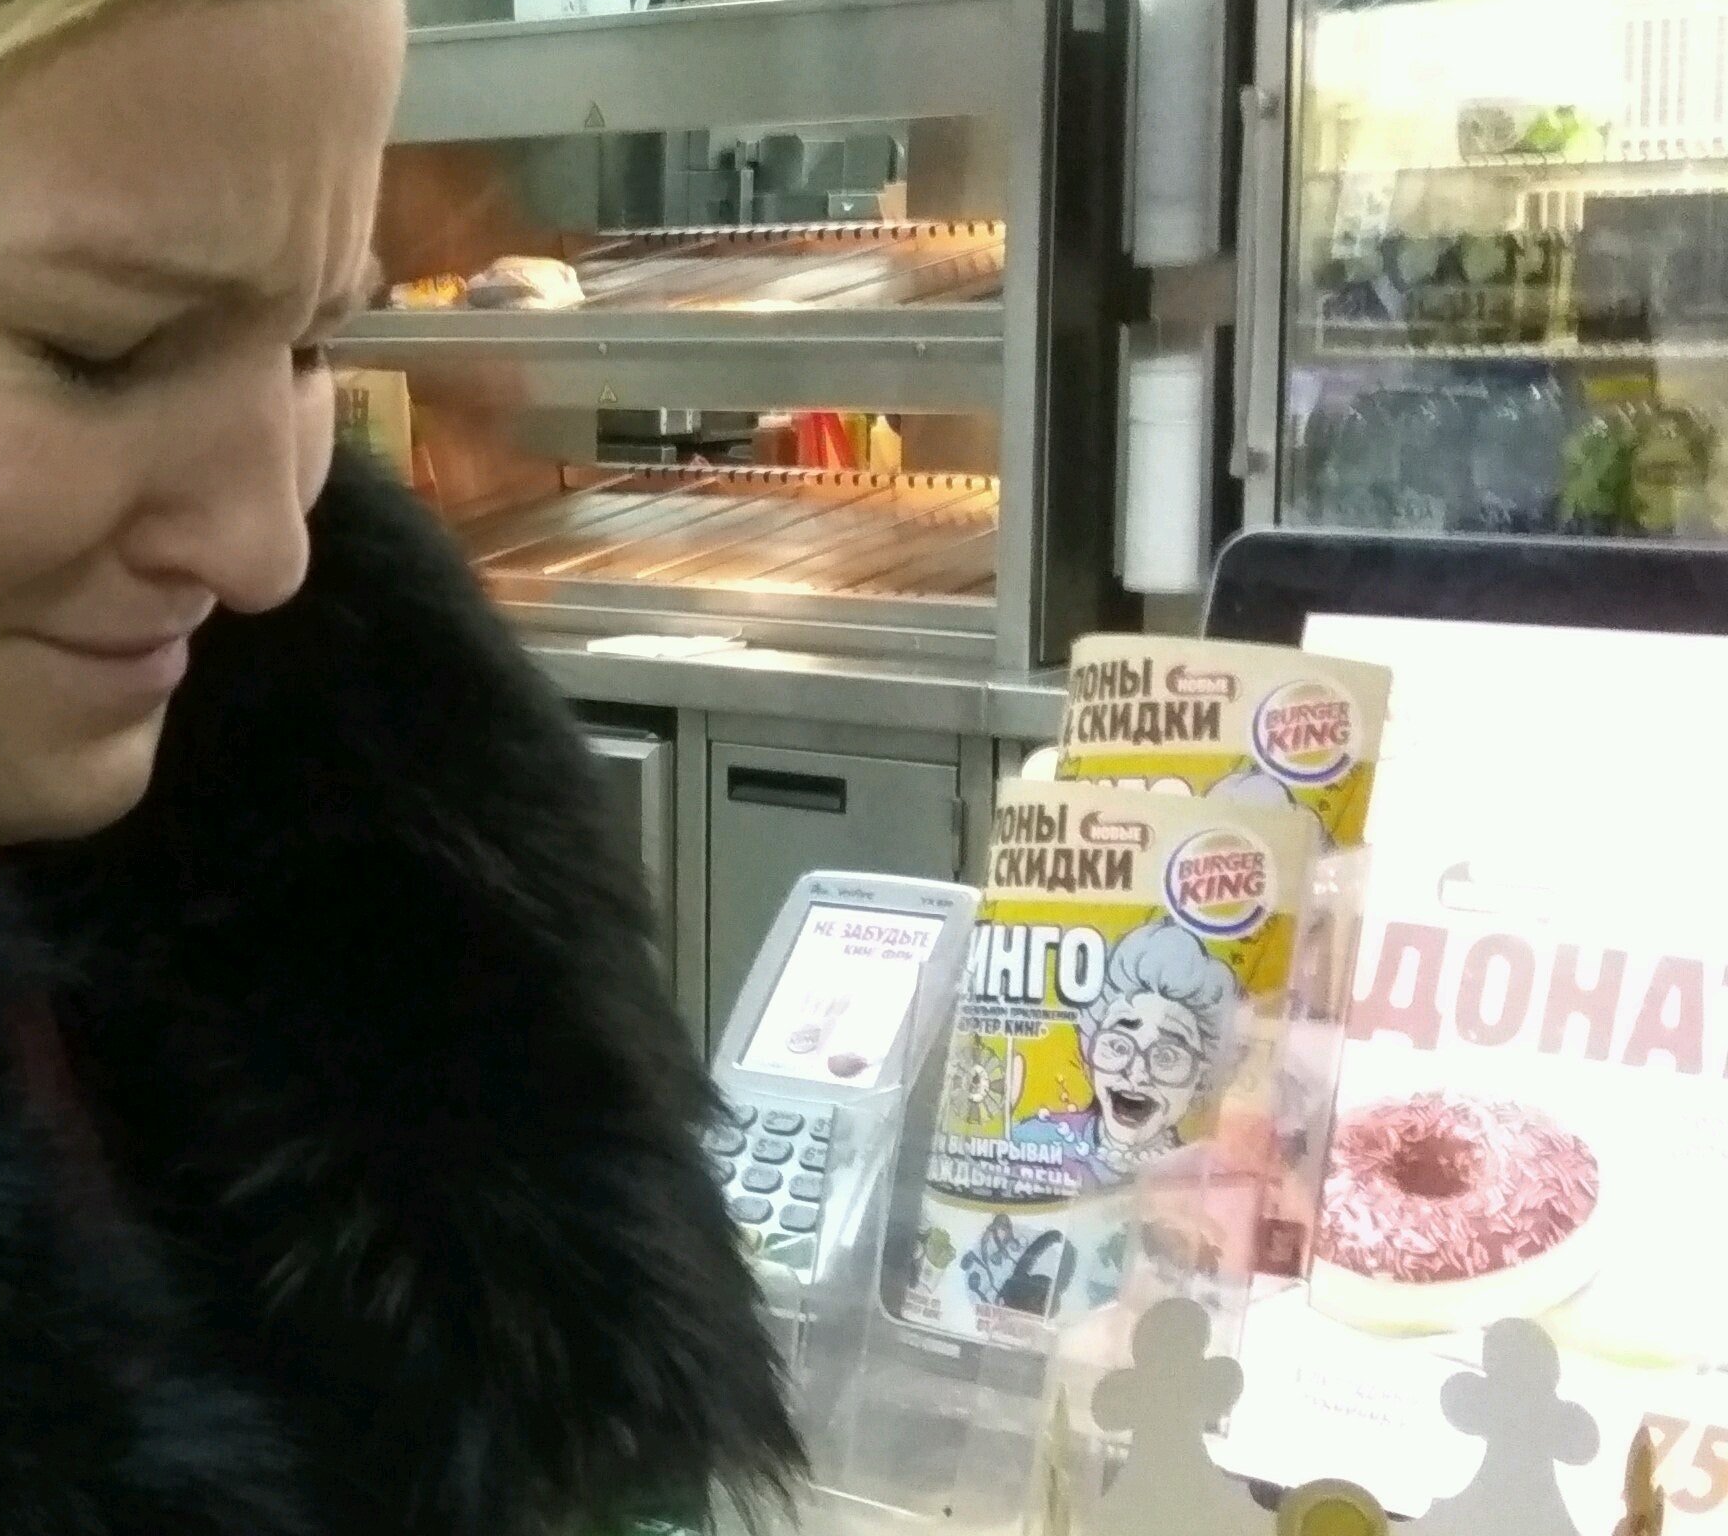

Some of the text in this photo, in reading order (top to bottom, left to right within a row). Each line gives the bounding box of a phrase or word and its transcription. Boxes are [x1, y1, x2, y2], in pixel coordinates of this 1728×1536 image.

[1078, 700, 1222, 745] СКИДКИ
[1265, 700, 1351, 731] BURGER
[1265, 720, 1351, 754] KING
[994, 847, 1133, 893] СКИДКИ
[1179, 851, 1266, 882] BURGER
[1179, 872, 1267, 905] KING
[840, 923, 931, 948] ЗАБУДЬТЕ
[1347, 921, 1728, 1078] ДОНА
